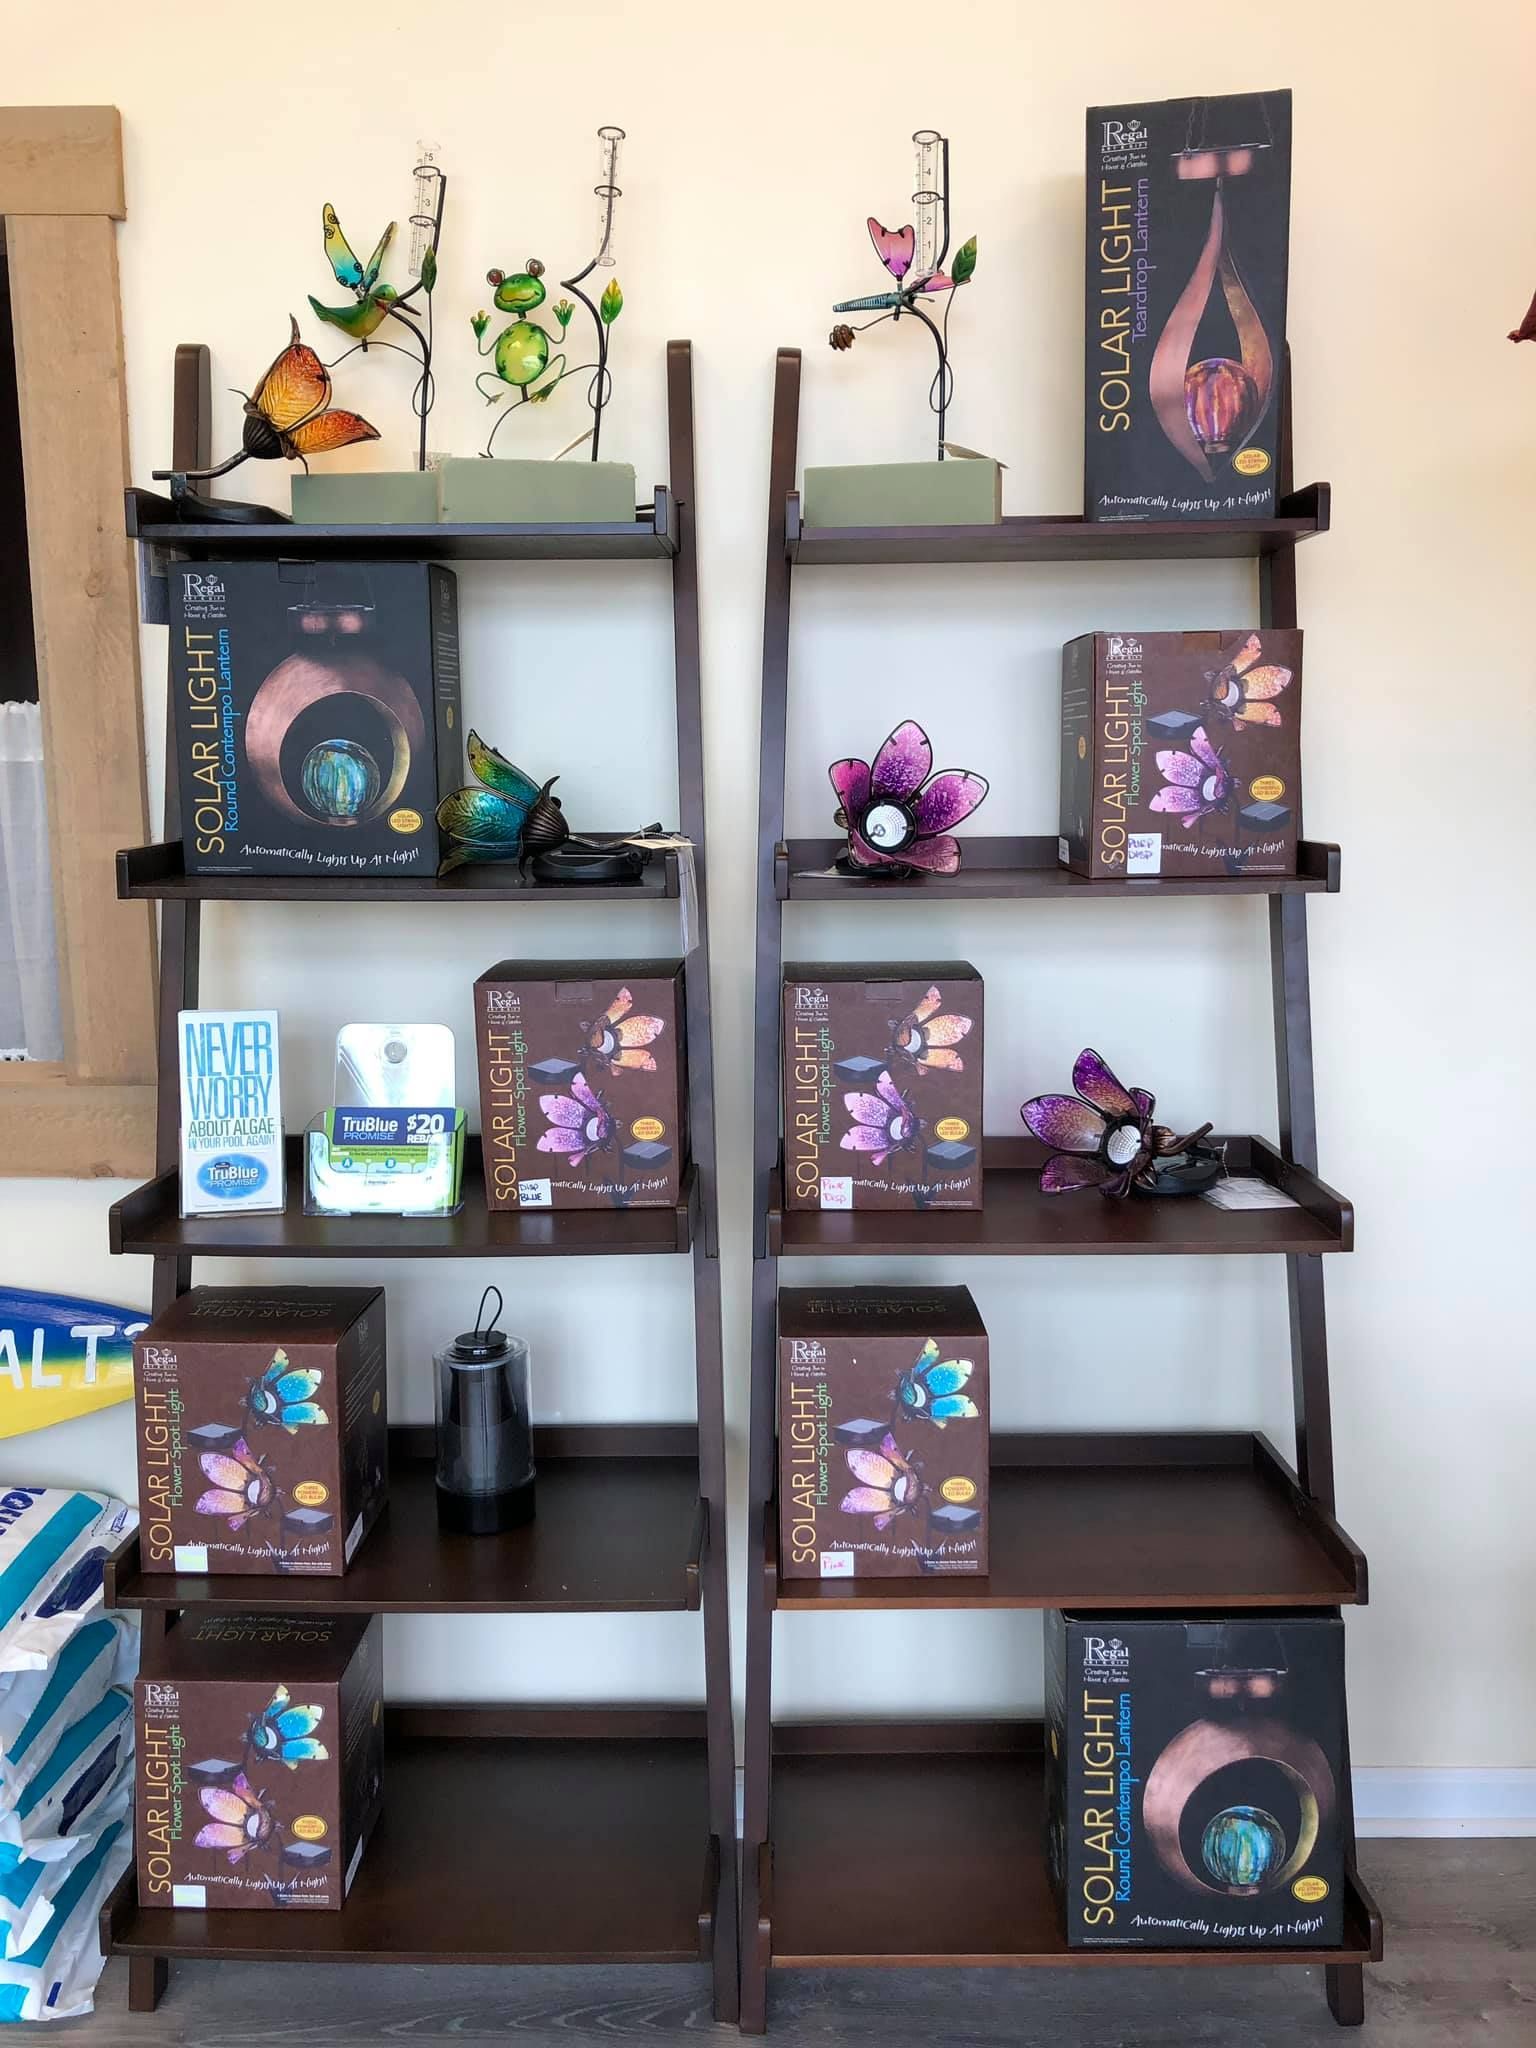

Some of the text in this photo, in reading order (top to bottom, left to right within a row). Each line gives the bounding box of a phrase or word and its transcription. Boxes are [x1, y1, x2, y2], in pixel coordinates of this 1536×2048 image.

[1101, 121, 1147, 146] Regal
[1101, 180, 1132, 294] LIGHT
[1129, 177, 1156, 343] Teardrop Lantern
[1100, 305, 1130, 432] SOLAR
[1204, 500, 1220, 512] Up
[182, 573, 224, 596] Regal
[1106, 637, 1142, 656] Regal
[186, 626, 218, 728] LIGHT
[218, 628, 240, 832] Round Contempo Lantern
[1104, 680, 1129, 763] LIGHT
[1124, 681, 1147, 806] Flower Spot Light
[192, 742, 225, 853] SOLAR
[1101, 772, 1127, 864] SOLAR
[350, 855, 366, 868] Up
[1228, 848, 1241, 858] Up
[486, 990, 520, 1008] Regal
[793, 987, 828, 1005] Regal
[186, 1021, 272, 1077] NEVER
[488, 1030, 513, 1107] LIGHT
[795, 1027, 817, 1103] LIGHT
[187, 1075, 273, 1120] WORRY
[509, 1030, 531, 1147] Flower Spot Light
[816, 1027, 836, 1144] Flower Spot Light
[189, 1118, 275, 1137] ABOUT ALGAE
[189, 1137, 197, 1149] IN
[199, 1136, 221, 1149] YOUR
[223, 1135, 246, 1147] POOL
[342, 1117, 398, 1132] TruBlue
[343, 1132, 395, 1141] PROMISE
[407, 1114, 445, 1134] $20
[207, 1166, 258, 1180] TruBlue
[493, 1116, 516, 1200] SOLAR
[796, 1112, 818, 1198] SOLAR
[210, 1179, 257, 1188] PROMISE
[519, 1192, 543, 1202] BLUE
[614, 1184, 627, 1194] Up
[917, 1184, 930, 1194] Up
[142, 1347, 177, 1365] Regal
[790, 1340, 826, 1359] Regal
[144, 1387, 169, 1465] LIGHT
[164, 1388, 187, 1507] Flower Spot Light
[791, 1383, 815, 1462] LIGHT
[813, 1383, 834, 1505] Flower Spot Light
[148, 1474, 173, 1561] SOLAR
[792, 1473, 816, 1562] SOLAR
[275, 1549, 287, 1559] Up
[920, 1547, 933, 1559] Up
[1082, 1637, 1129, 1660] Regal
[144, 1684, 178, 1702] Regal
[145, 1723, 169, 1800] LIGHT
[1084, 1690, 1114, 1795] LIGHT
[163, 1724, 187, 1840] Flower Spot Light
[1112, 1693, 1140, 1902] Round Contempo Lantern
[147, 1808, 171, 1893] SOLAR
[1083, 1807, 1114, 1925] SOLAR
[272, 1880, 285, 1891] Up
[1249, 1924, 1267, 1938] Up
